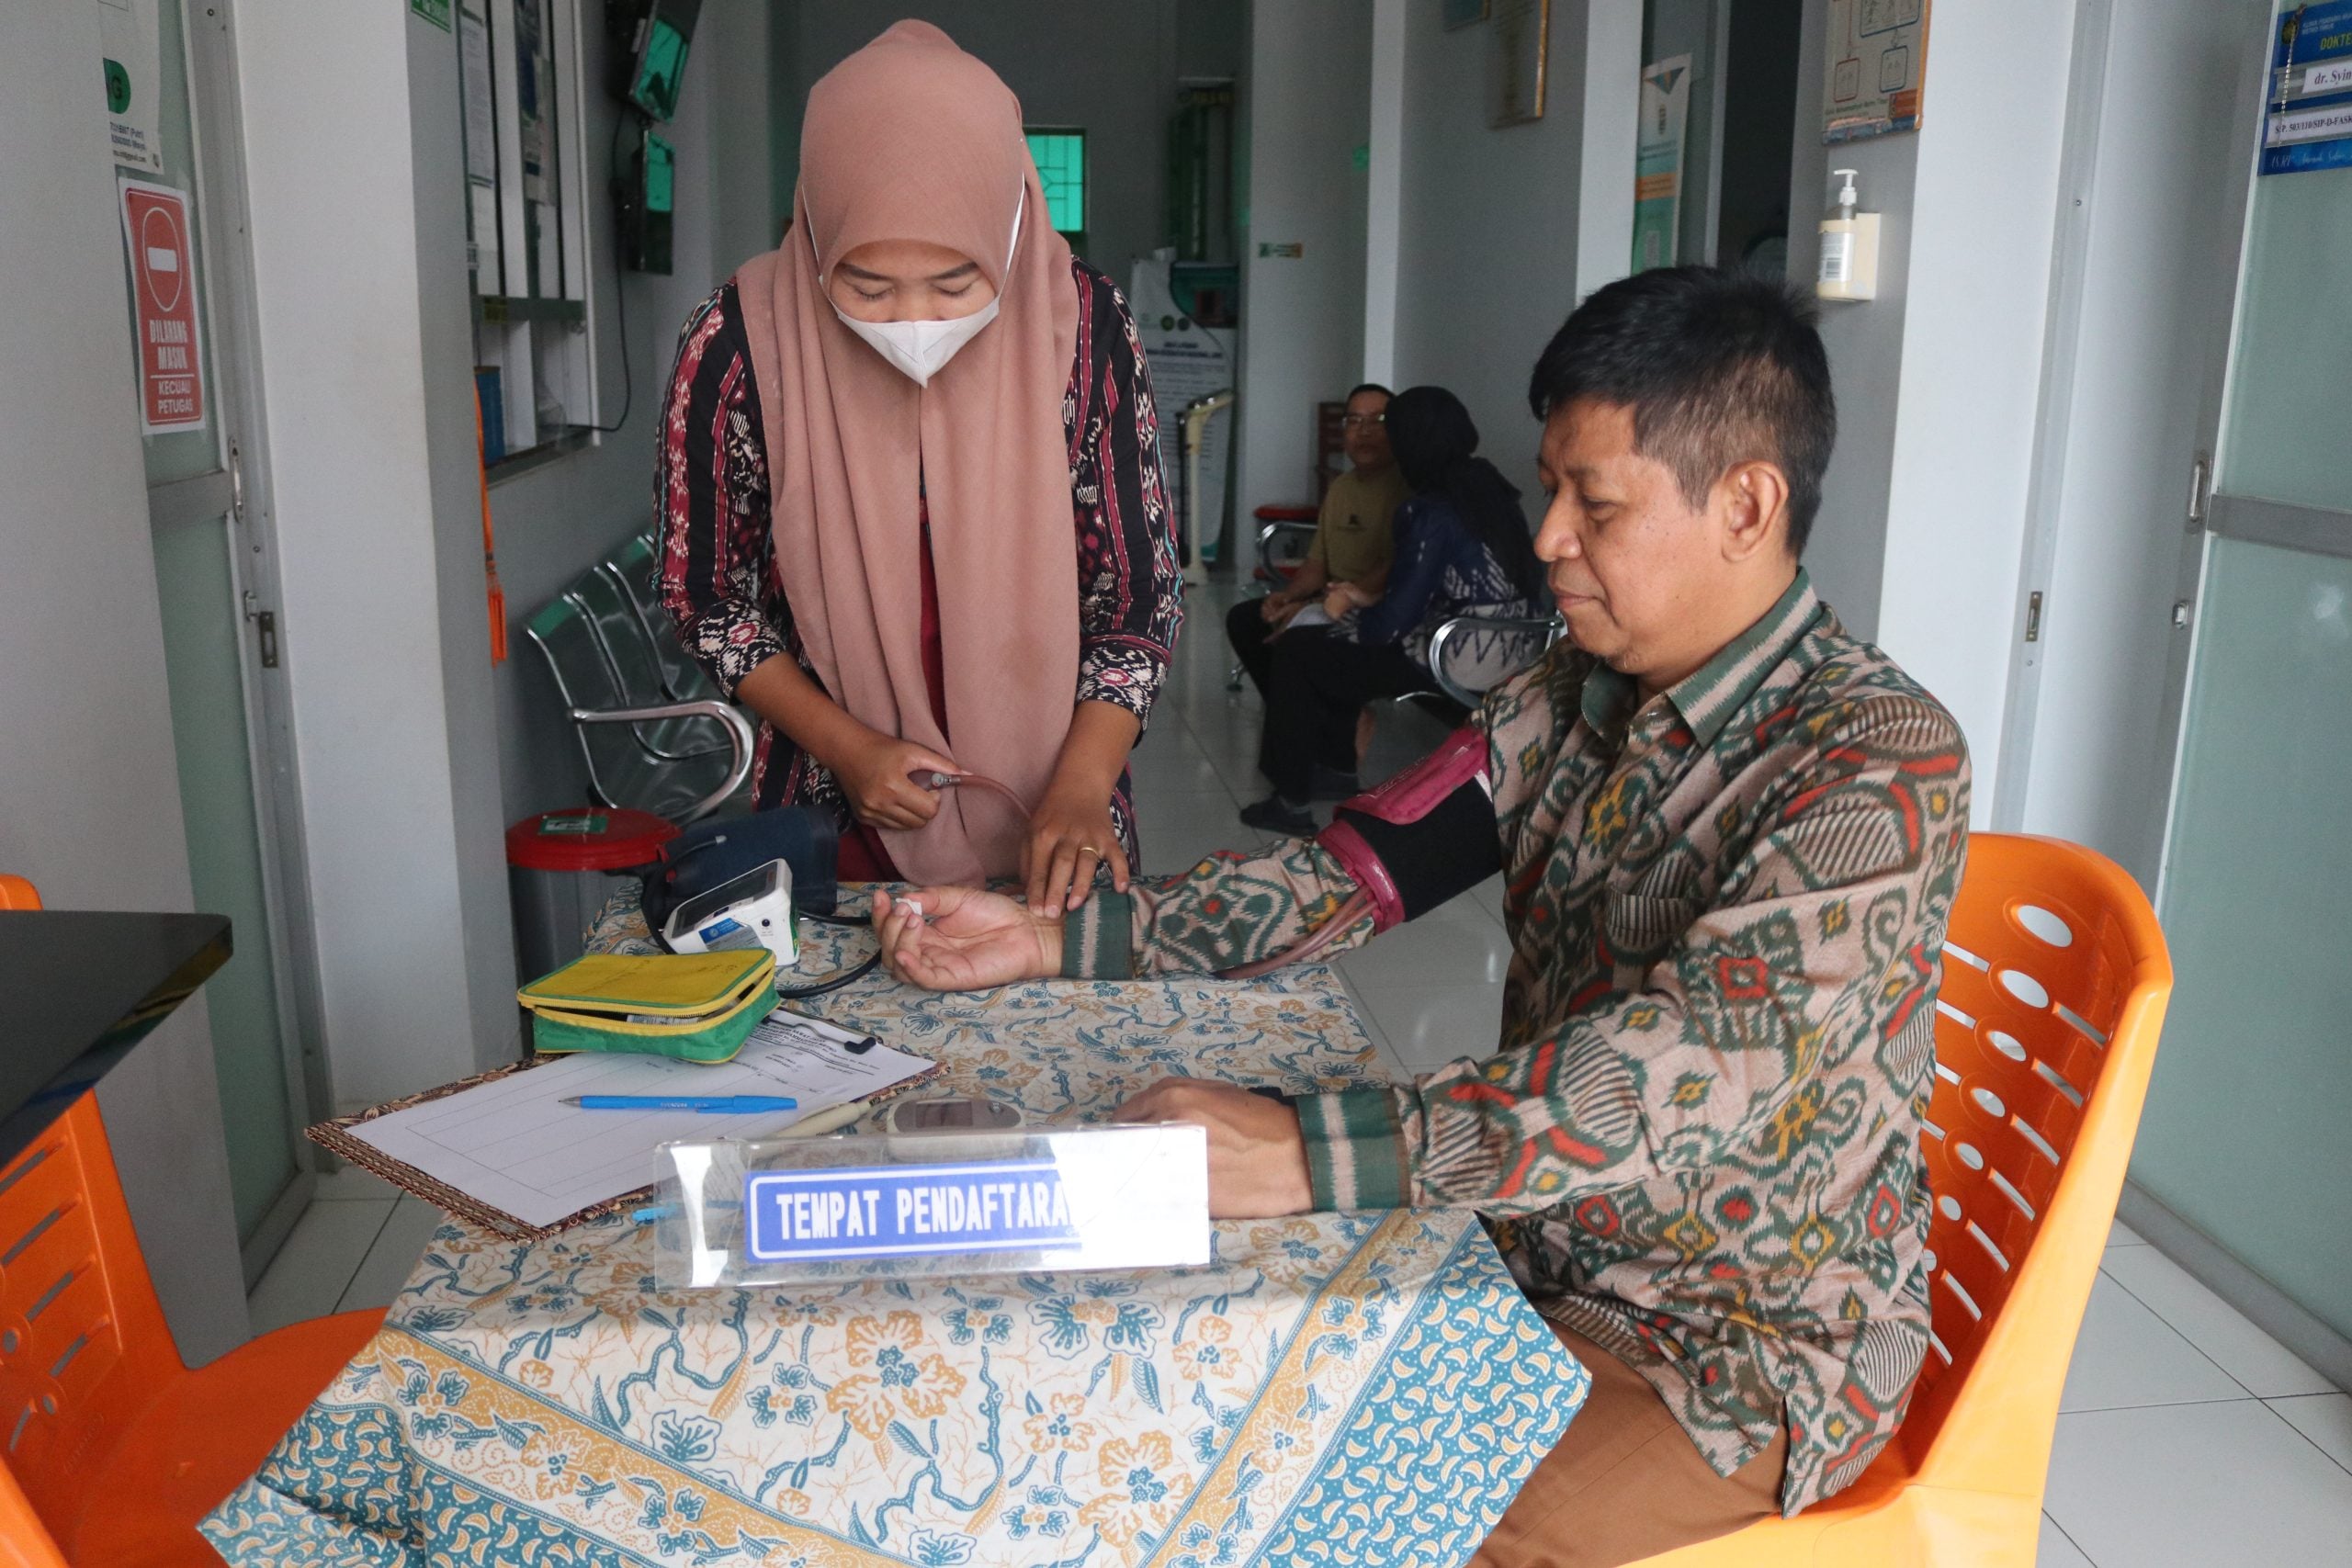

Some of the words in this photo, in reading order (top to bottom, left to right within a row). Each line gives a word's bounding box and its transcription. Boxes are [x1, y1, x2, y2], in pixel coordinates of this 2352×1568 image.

[2314, 73, 2327, 85] dr.
[150, 320, 188, 344] DILARANG
[158, 346, 188, 370] MASUK
[158, 399, 194, 414] PETUGAS
[776, 1190, 879, 1240] TEMPAT
[897, 1180, 1070, 1235] PENDAFTARA
